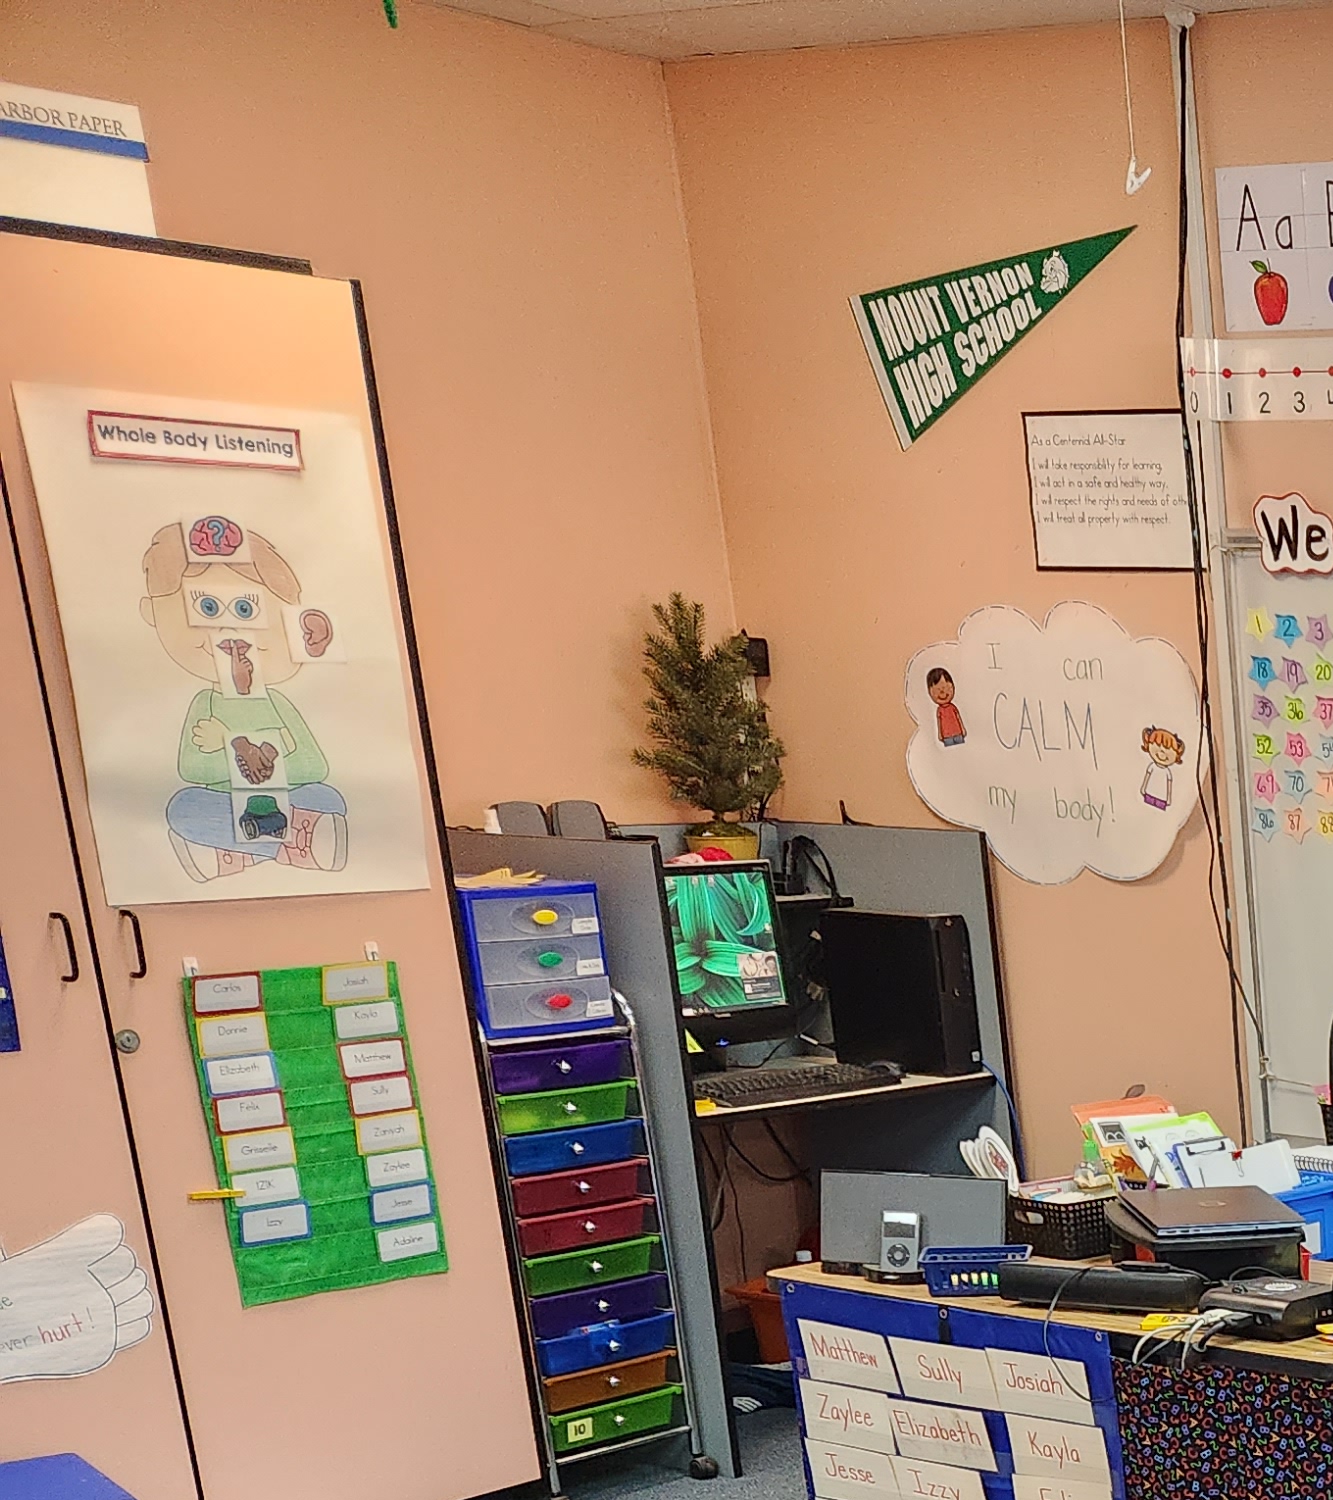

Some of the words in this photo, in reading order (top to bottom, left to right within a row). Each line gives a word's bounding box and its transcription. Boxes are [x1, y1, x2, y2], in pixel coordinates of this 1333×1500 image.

[68, 114, 127, 138] PAPER
[869, 286, 950, 361] MOUNT
[944, 262, 1034, 323] VERNON
[893, 342, 958, 430] HIGH
[954, 292, 1042, 378] SCHOOL
[97, 425, 156, 444] Whole
[164, 430, 208, 450] Body
[216, 435, 293, 458] Listening
[1031, 435, 1042, 445] As
[1085, 476, 1101, 488] safe
[1104, 476, 1118, 487] and
[1120, 477, 1146, 491] healthy
[1262, 504, 1328, 564] We
[987, 642, 1003, 670] I
[1063, 657, 1103, 681] can
[993, 693, 1098, 769] CALM
[989, 785, 1017, 824] my
[1054, 786, 1116, 837] body!
[809, 1333, 877, 1369] Matthew
[918, 1355, 962, 1394] Sully
[1003, 1362, 1063, 1396] Josiah
[573, 1423, 586, 1437] 10
[895, 1411, 981, 1446] Elizabeth
